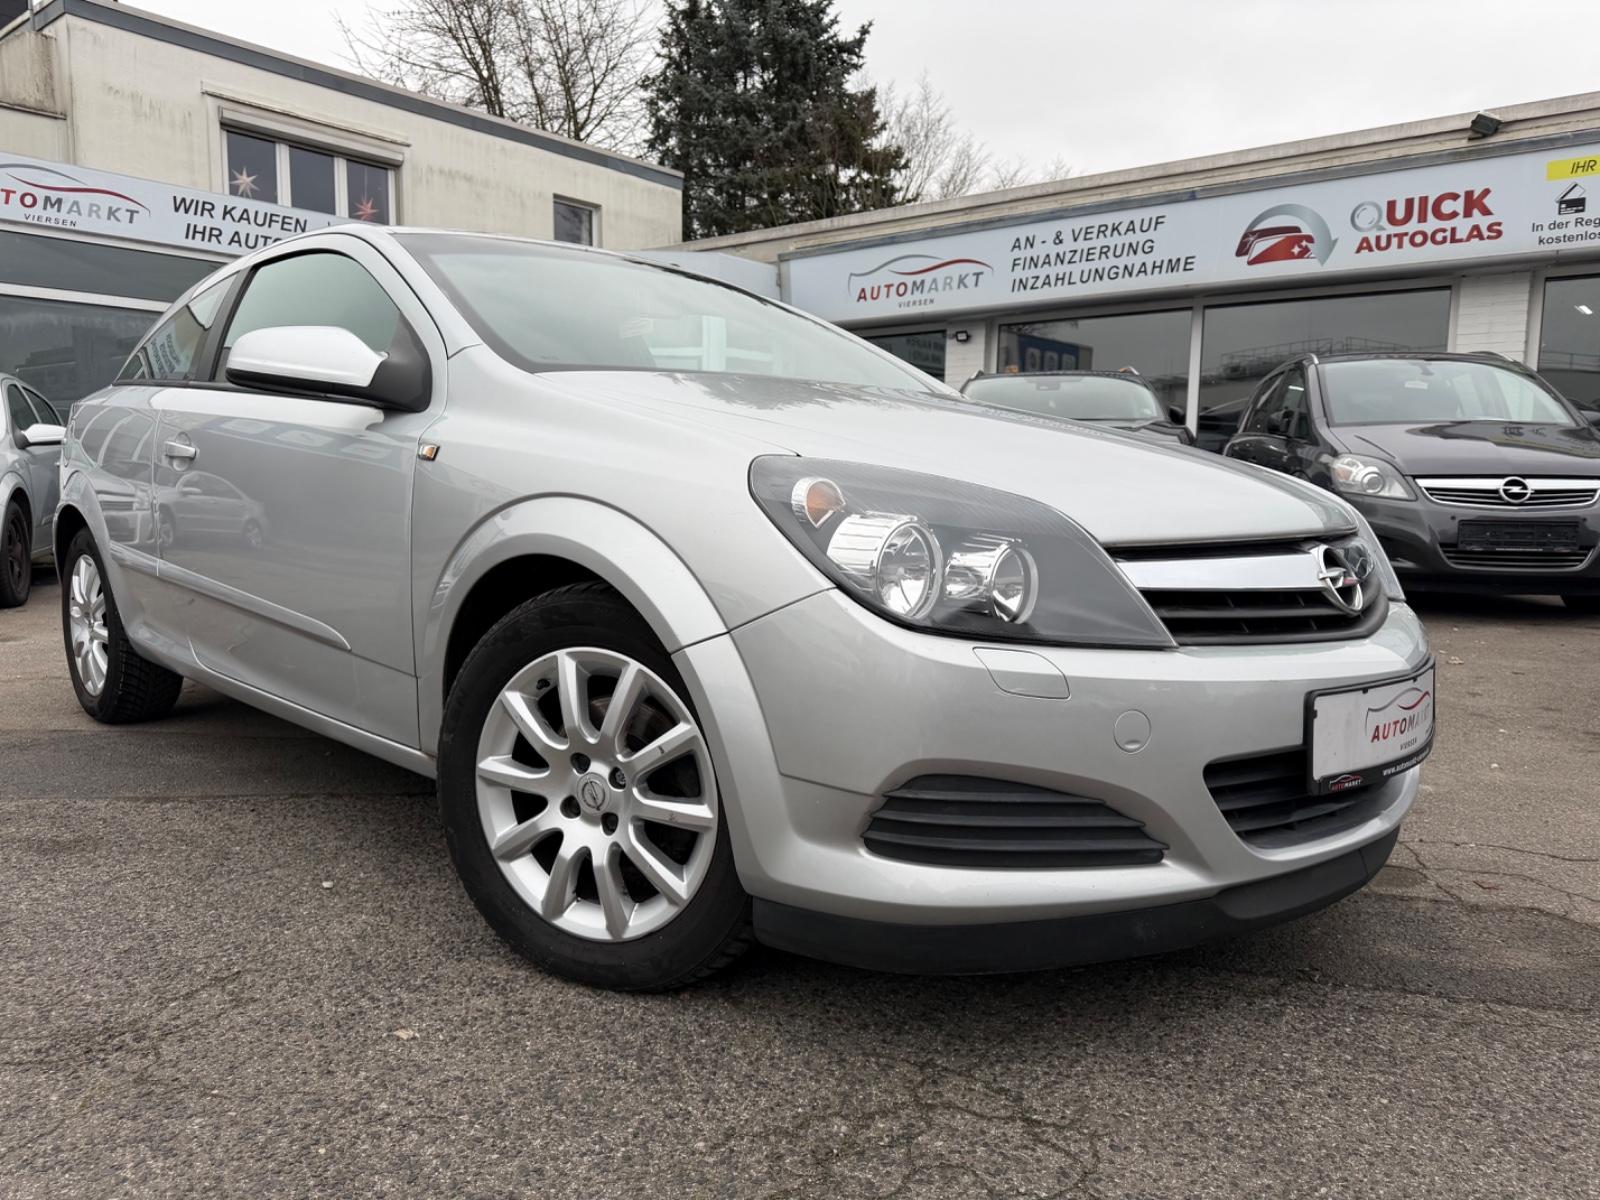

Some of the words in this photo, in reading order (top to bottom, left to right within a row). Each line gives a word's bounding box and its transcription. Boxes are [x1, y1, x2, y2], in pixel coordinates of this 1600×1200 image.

[1570, 160, 1597, 175] IHR
[24, 213, 77, 228] VIERSEN
[172, 195, 215, 219] WIR
[222, 205, 308, 233] KAUFEN
[1350, 187, 1494, 233] QUICK
[185, 222, 221, 244] IHR
[1010, 235, 1036, 252] AN
[1052, 229, 1064, 246] &
[1071, 215, 1167, 243] VERKAUF
[1355, 221, 1504, 254] AUTOGLAS
[1531, 222, 1544, 233] In
[1548, 220, 1571, 231] der
[1010, 239, 1156, 273] FINANZIERUNG
[856, 271, 985, 303] AUTOMARKT
[1010, 255, 1197, 293] INZAHLUNGNAHME
[898, 298, 935, 309] VIERSEN
